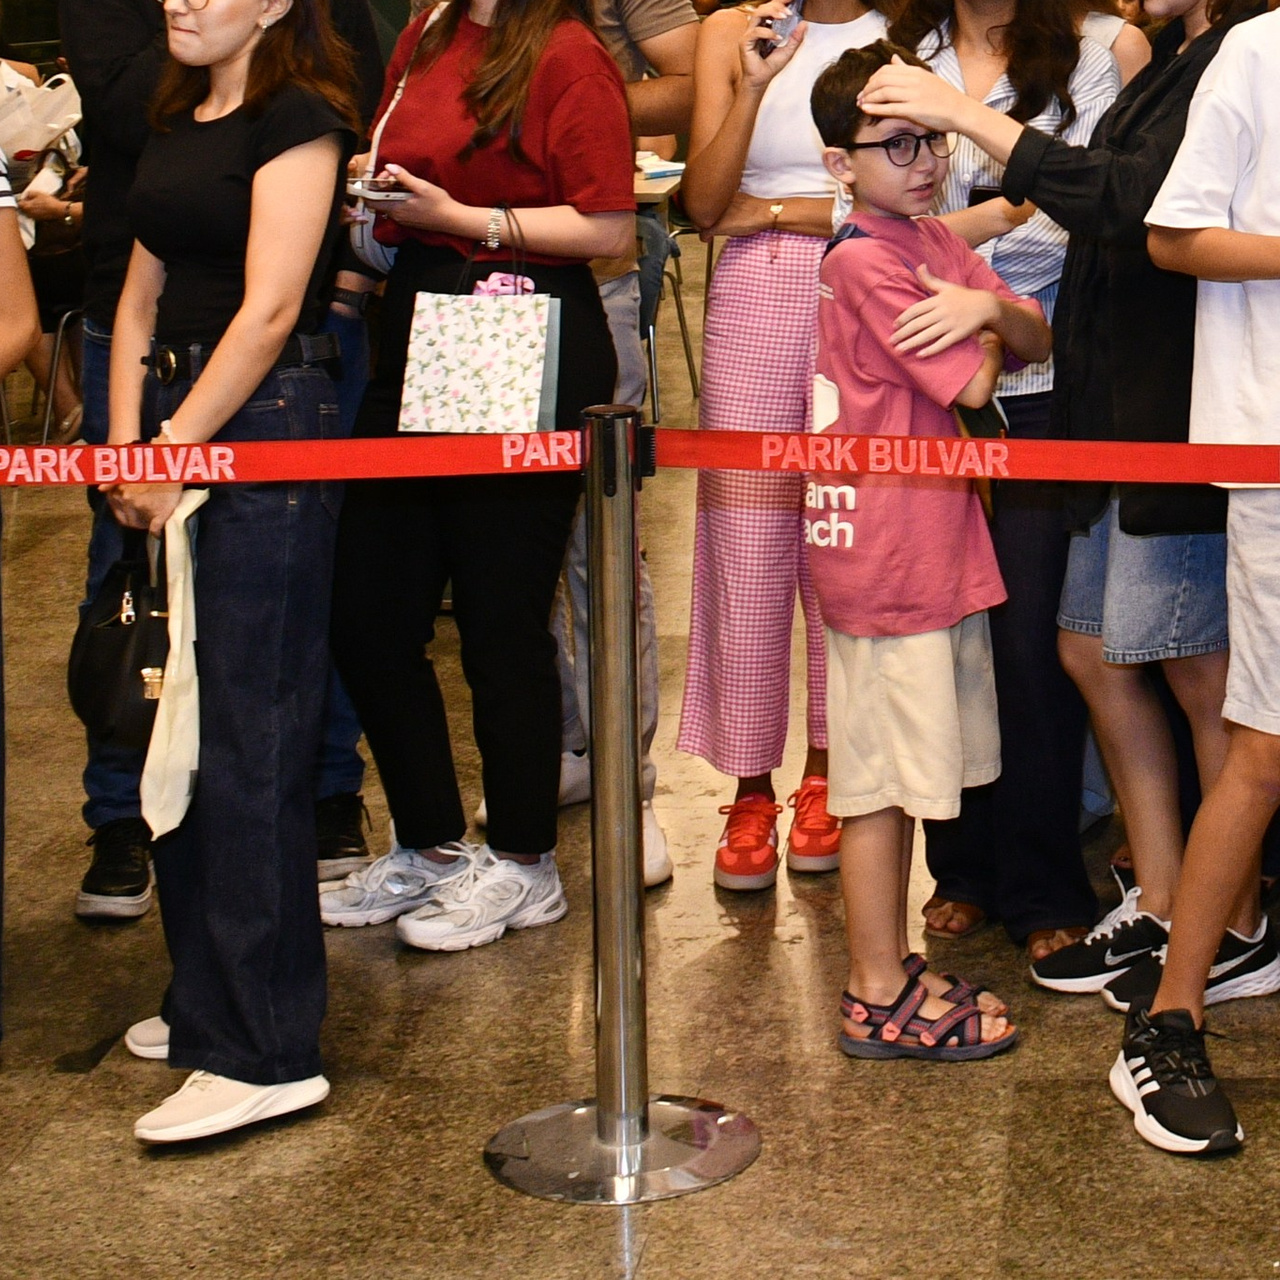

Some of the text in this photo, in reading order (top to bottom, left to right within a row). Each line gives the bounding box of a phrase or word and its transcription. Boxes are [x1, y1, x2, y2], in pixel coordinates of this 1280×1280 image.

[94, 446, 237, 482] BULVAR
[761, 434, 1010, 476] PARK BULVAR
